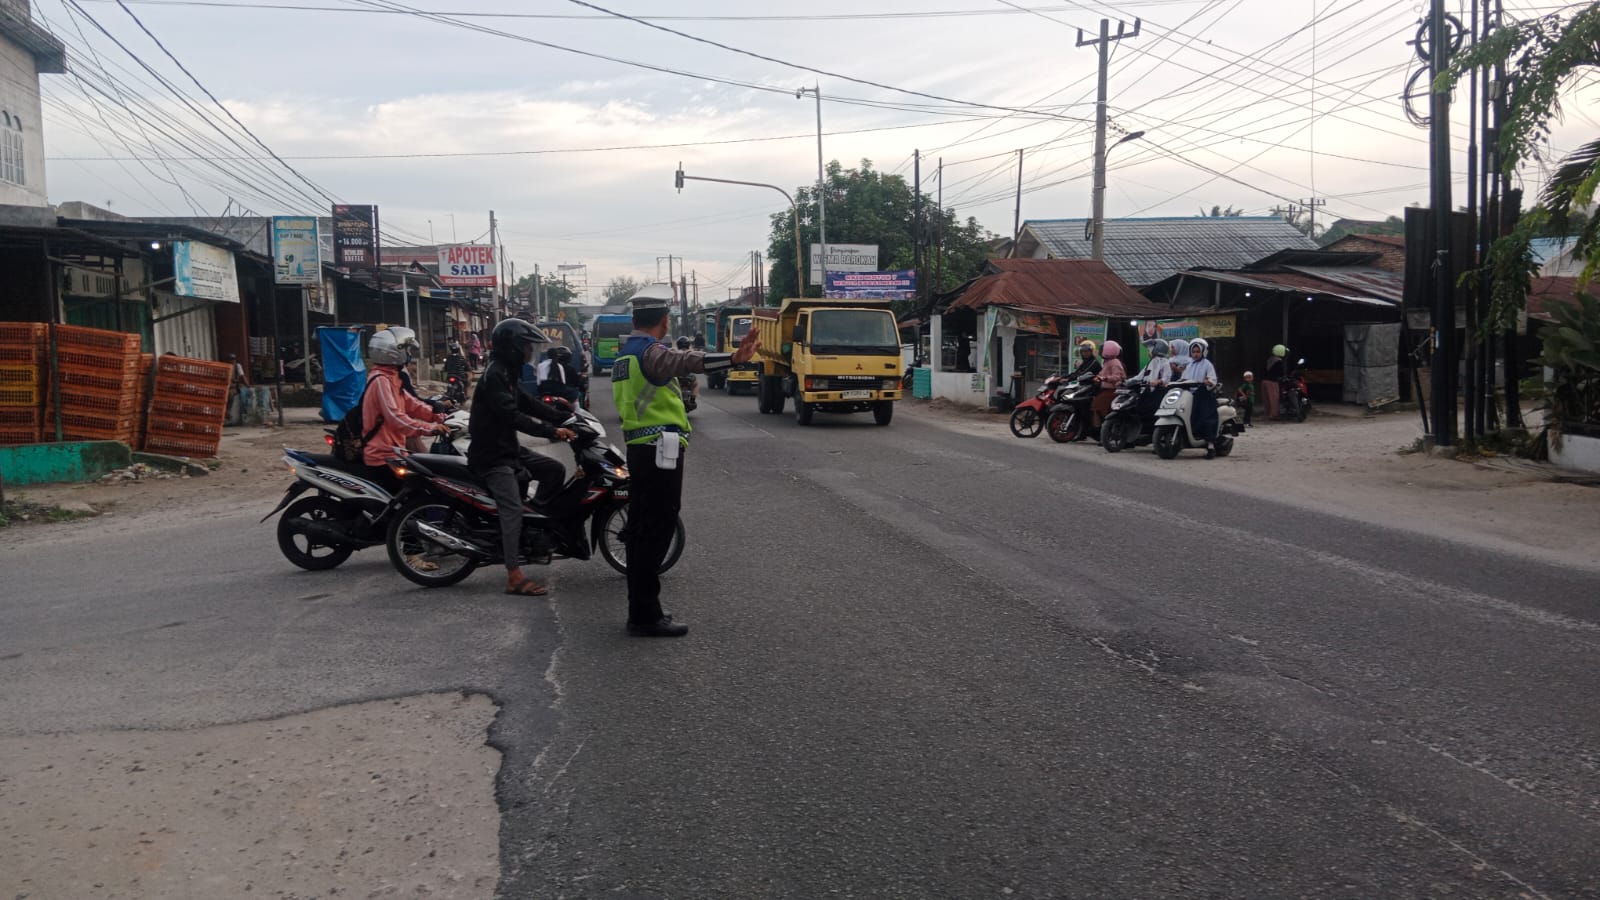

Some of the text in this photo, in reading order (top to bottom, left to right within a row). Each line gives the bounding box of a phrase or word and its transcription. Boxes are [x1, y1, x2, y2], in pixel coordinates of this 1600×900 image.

[448, 246, 495, 264] APOTEK
[451, 264, 486, 276] SARI
[542, 327, 564, 338] ORA
